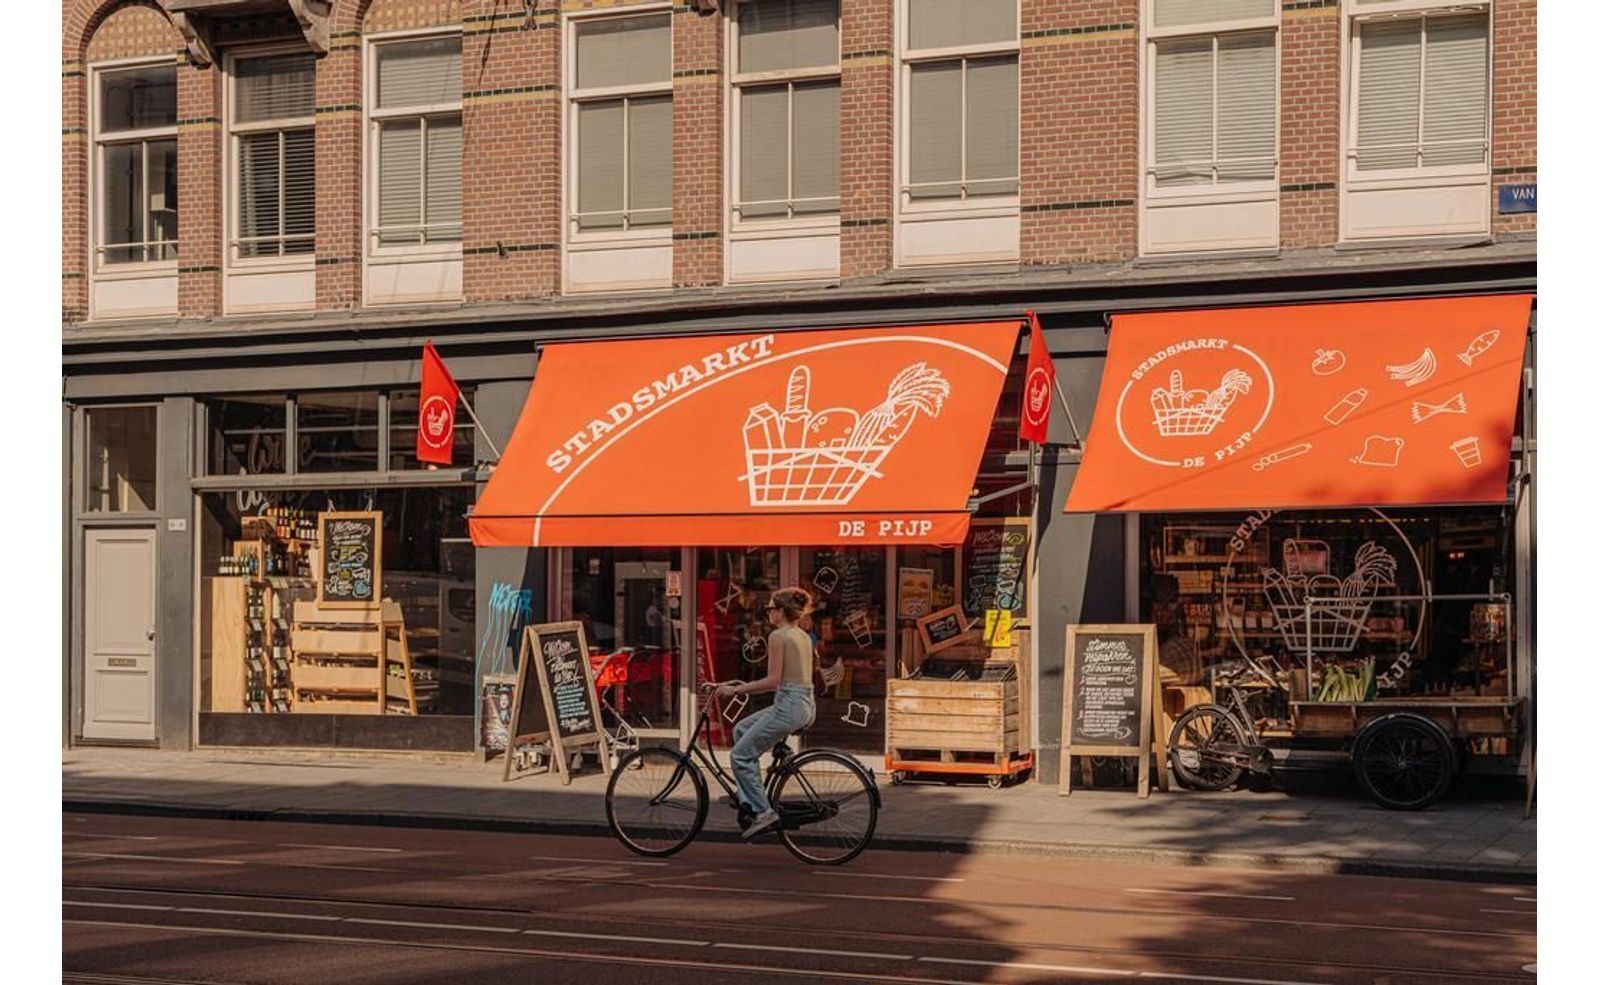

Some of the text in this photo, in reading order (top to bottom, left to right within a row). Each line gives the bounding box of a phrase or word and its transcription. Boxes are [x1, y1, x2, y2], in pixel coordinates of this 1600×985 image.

[1512, 187, 1535, 200] VAN
[1132, 338, 1228, 381] STADSMARKT
[546, 334, 776, 475] STADSMARKT
[1182, 431, 1253, 469] DE PIJP
[838, 520, 933, 537] DE PIJP
[1229, 508, 1283, 552] STAD
[1376, 651, 1413, 689] IJP
